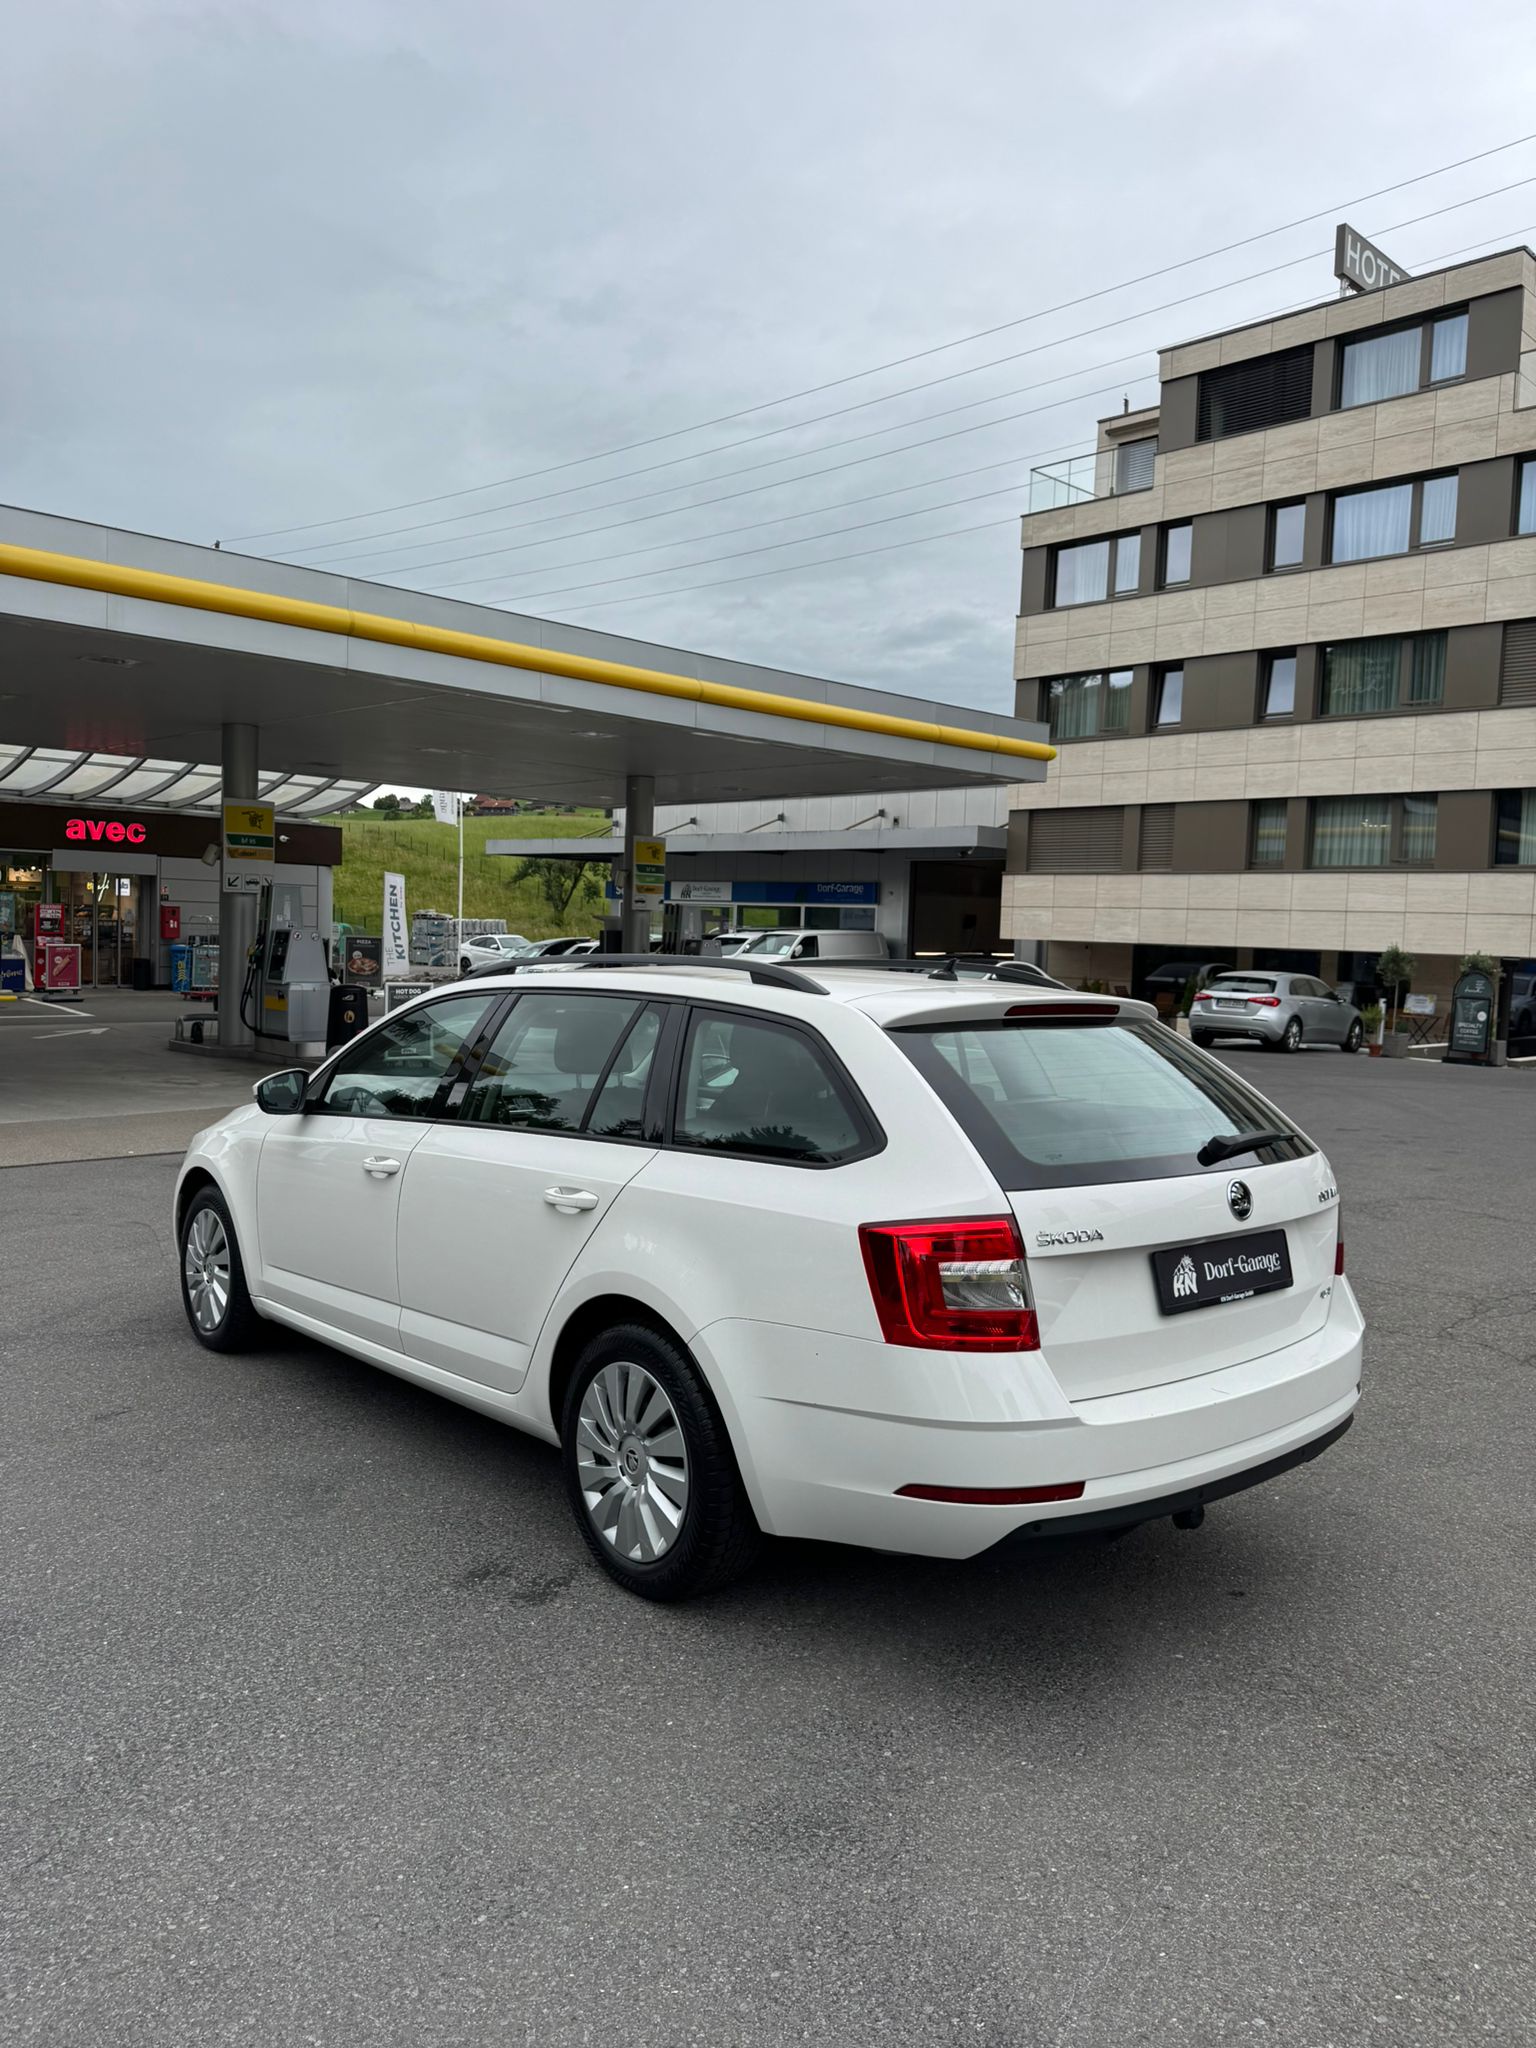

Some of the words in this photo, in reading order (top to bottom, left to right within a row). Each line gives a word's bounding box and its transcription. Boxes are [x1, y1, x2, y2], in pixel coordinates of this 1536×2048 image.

[66, 819, 146, 843] avec
[817, 883, 864, 894] Dorf-Garage
[389, 884, 406, 960] KITCHEN
[385, 947, 395, 966] THE
[1036, 1229, 1104, 1247] ŠKODA
[1203, 1252, 1281, 1281] Dorf-Garage
[1172, 1271, 1199, 1298] KN
